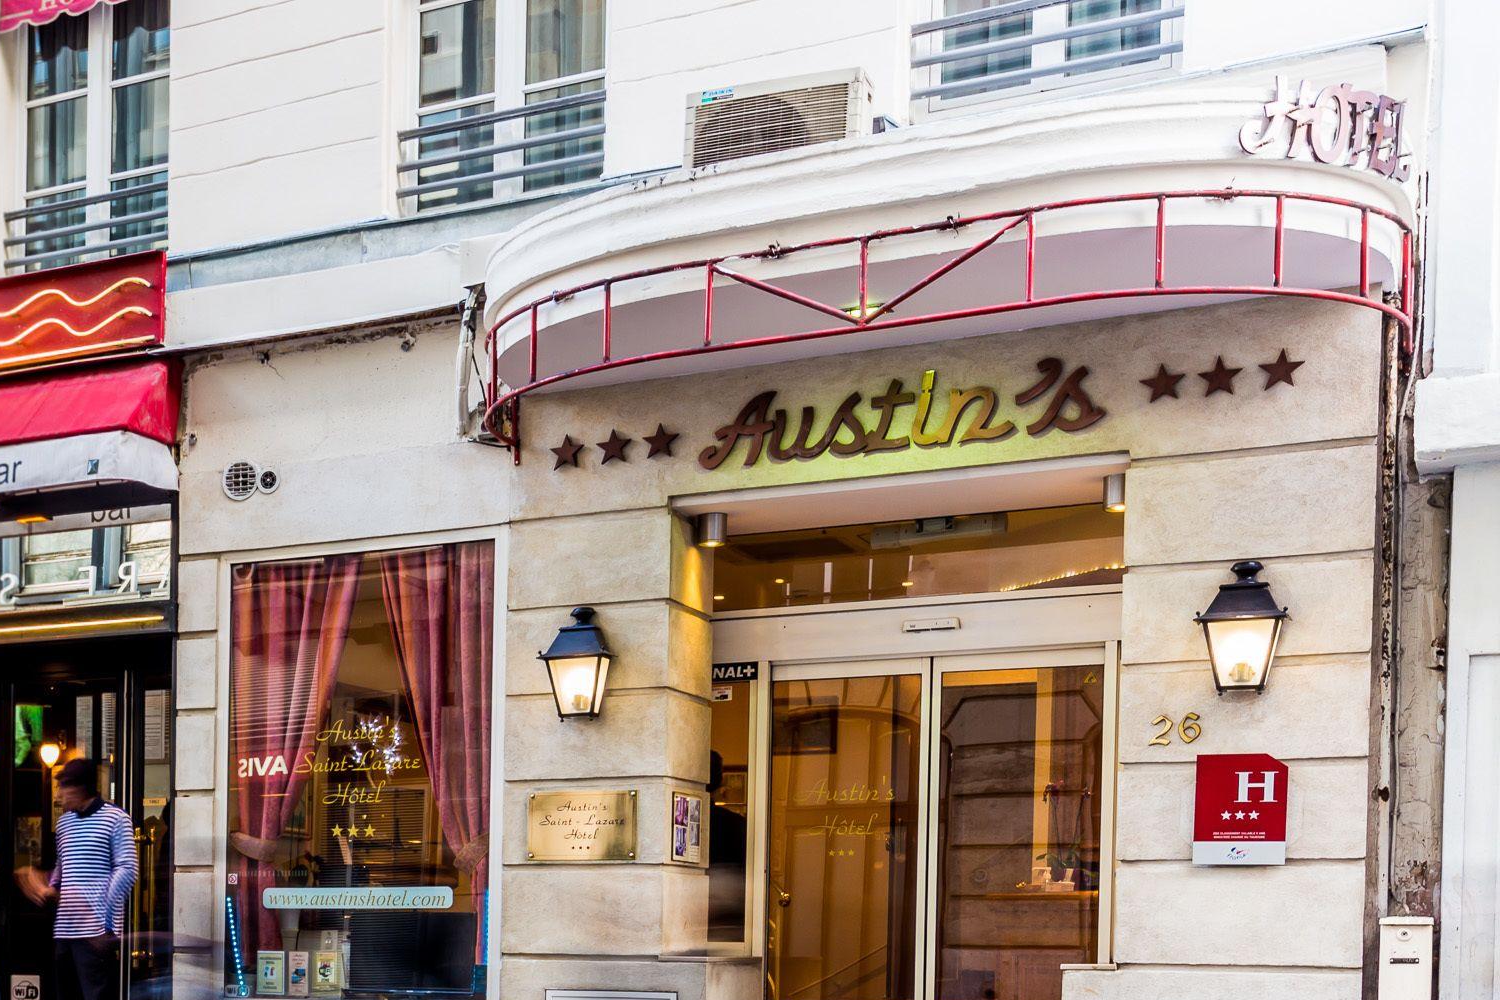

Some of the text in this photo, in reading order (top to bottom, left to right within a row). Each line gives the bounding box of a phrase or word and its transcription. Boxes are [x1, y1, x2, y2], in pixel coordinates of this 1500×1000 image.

[698, 357, 1107, 471] Austin's
[1148, 712, 1202, 746] 26
[322, 780, 386, 806] Hôtel
[795, 775, 895, 803] Austin's
[1233, 771, 1280, 803] H
[557, 801, 608, 812] Austin's
[808, 813, 878, 838] Hôtel
[269, 890, 446, 907] www.austinshotel.com
